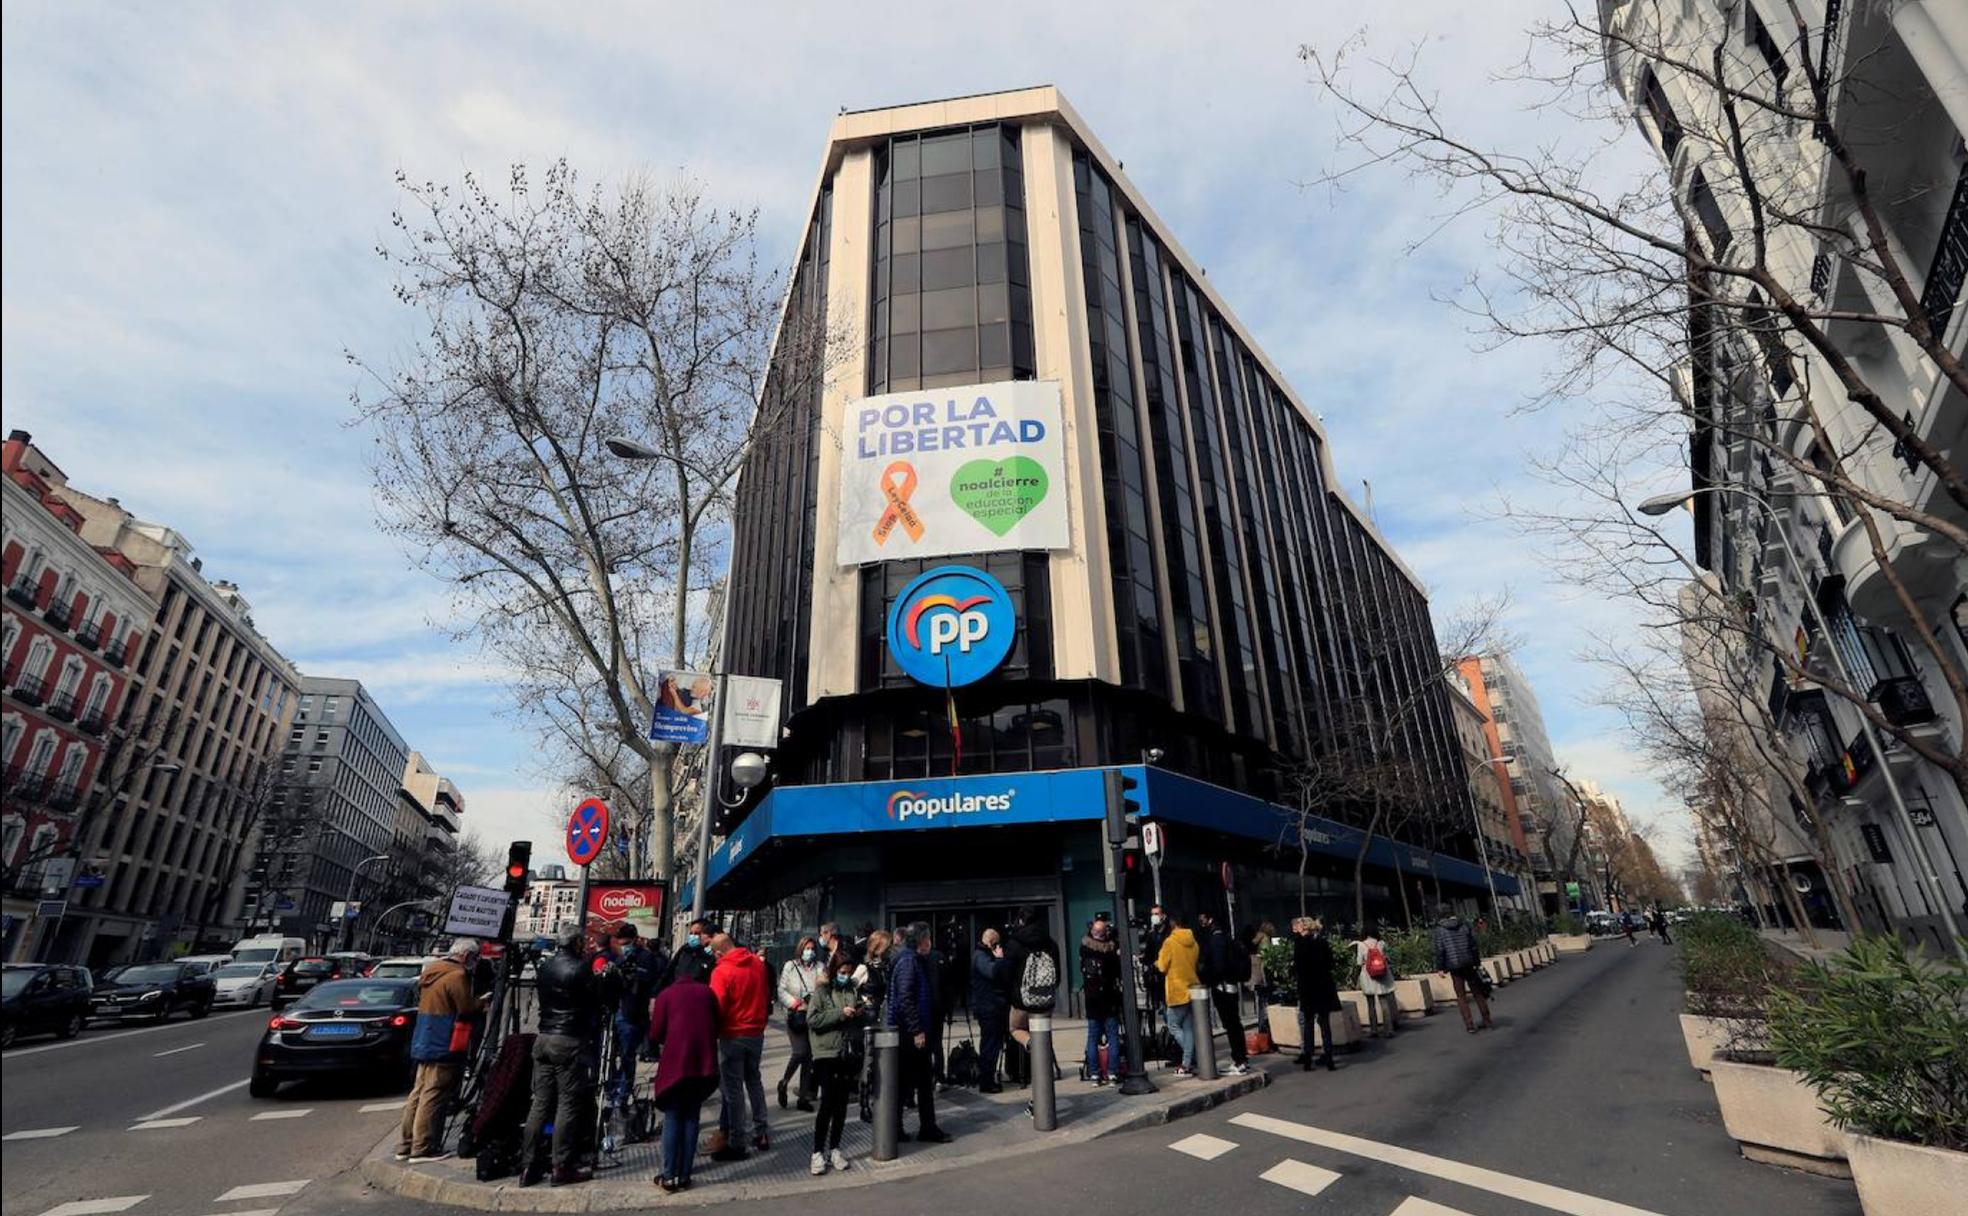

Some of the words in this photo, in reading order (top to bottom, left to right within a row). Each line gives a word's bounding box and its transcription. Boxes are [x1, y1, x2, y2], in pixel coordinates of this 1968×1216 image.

[858, 403, 936, 433] POR
[946, 396, 997, 422] LA
[857, 420, 1046, 459] LIBERTAD
[959, 477, 1040, 491] noalcierre
[973, 504, 1028, 519] especial
[603, 894, 642, 908] nocilla
